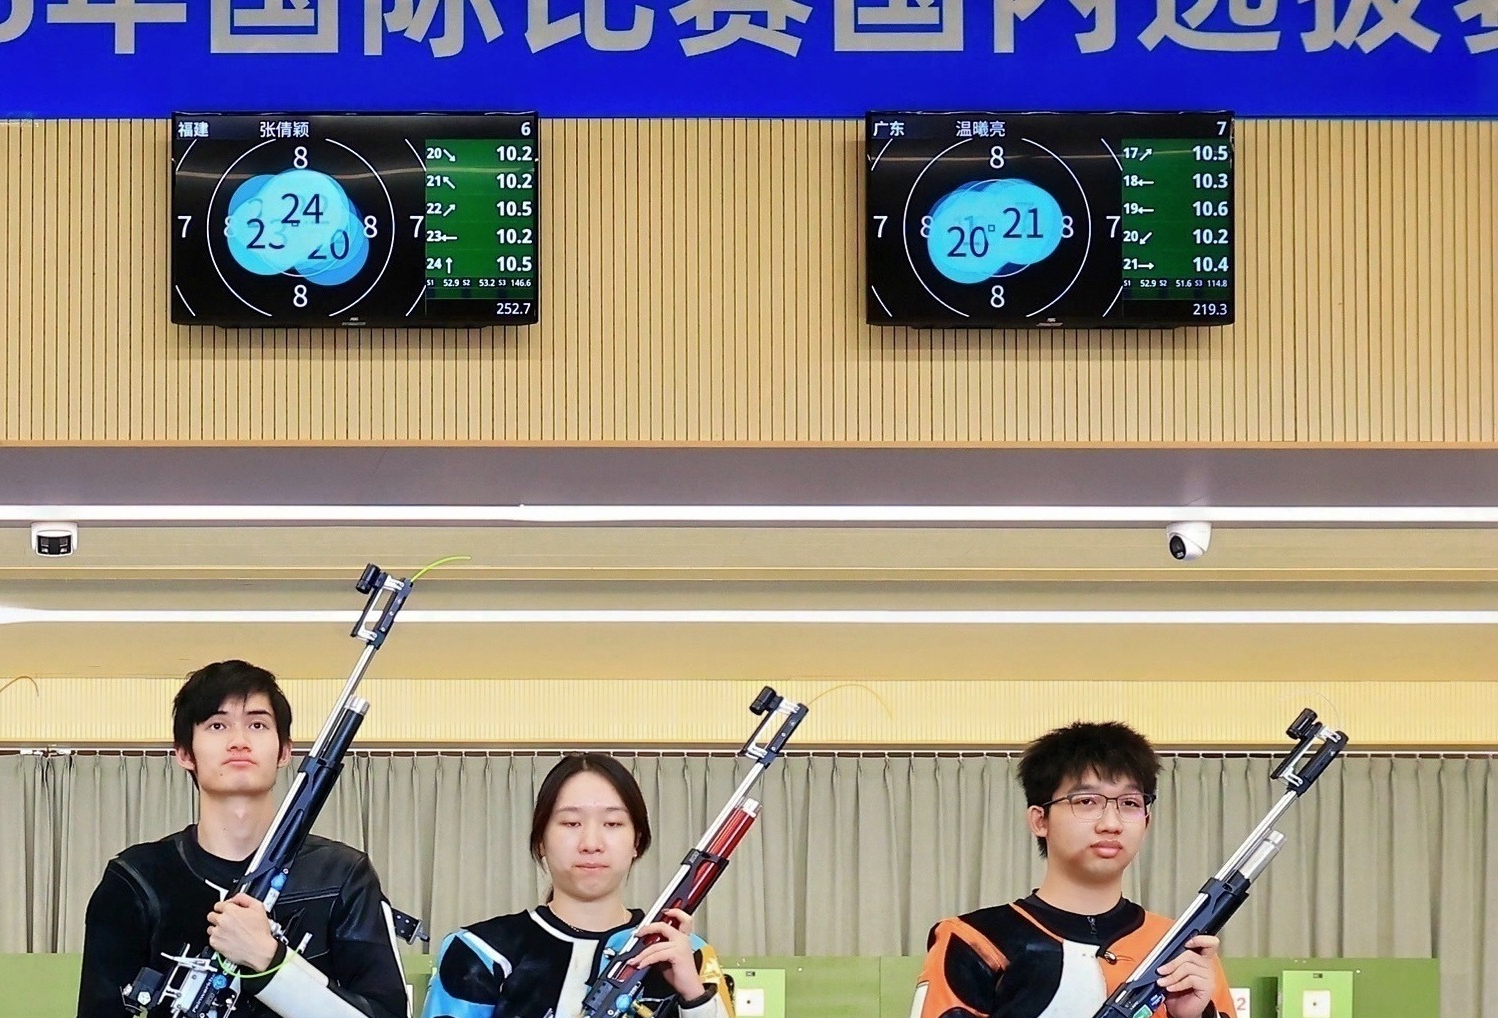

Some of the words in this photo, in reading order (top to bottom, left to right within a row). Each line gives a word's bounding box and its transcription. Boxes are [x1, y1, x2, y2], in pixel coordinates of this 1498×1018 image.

[178, 121, 209, 138] 福建
[260, 121, 310, 138] 张倩颖
[521, 122, 531, 136] 6
[873, 121, 904, 137] 广东
[1216, 121, 1227, 135] 7
[293, 146, 308, 168] 8
[426, 148, 442, 159] 20
[497, 146, 532, 161] 10.2
[990, 146, 1004, 169] 8
[1123, 148, 1138, 158] 17
[1193, 145, 1228, 161] 10.5
[426, 175, 441, 187] 21
[497, 173, 532, 188] 10.2
[1123, 175, 1138, 186] 18
[1193, 173, 1228, 188] 10.3
[280, 193, 324, 224] 24
[426, 203, 442, 214] 22
[497, 201, 532, 216] 10.5
[1123, 203, 1138, 214] 19
[1193, 201, 1228, 216] 10.6
[177, 216, 192, 238] 7
[363, 215, 378, 238] 8
[409, 216, 424, 238] 7
[873, 216, 888, 238] 7
[920, 216, 933, 238] 8
[1003, 207, 1044, 239] 21
[1061, 216, 1074, 239] 8
[1106, 216, 1121, 238] 7
[426, 231, 441, 242] 23
[497, 229, 532, 244] 10.2
[947, 226, 989, 258] 20
[1123, 231, 1138, 242] 20
[1193, 229, 1229, 244] 10.2
[426, 258, 442, 269] 24
[497, 256, 532, 271] 10.5
[1123, 259, 1138, 270] 21
[1193, 256, 1229, 272] 10.4
[443, 279, 459, 287] 52.9
[479, 279, 495, 287] 53.2
[511, 279, 532, 287] 146.6
[293, 285, 308, 307] 8
[990, 285, 1004, 308] 8
[496, 303, 531, 315] 252.7
[1193, 304, 1227, 315] 219.3
